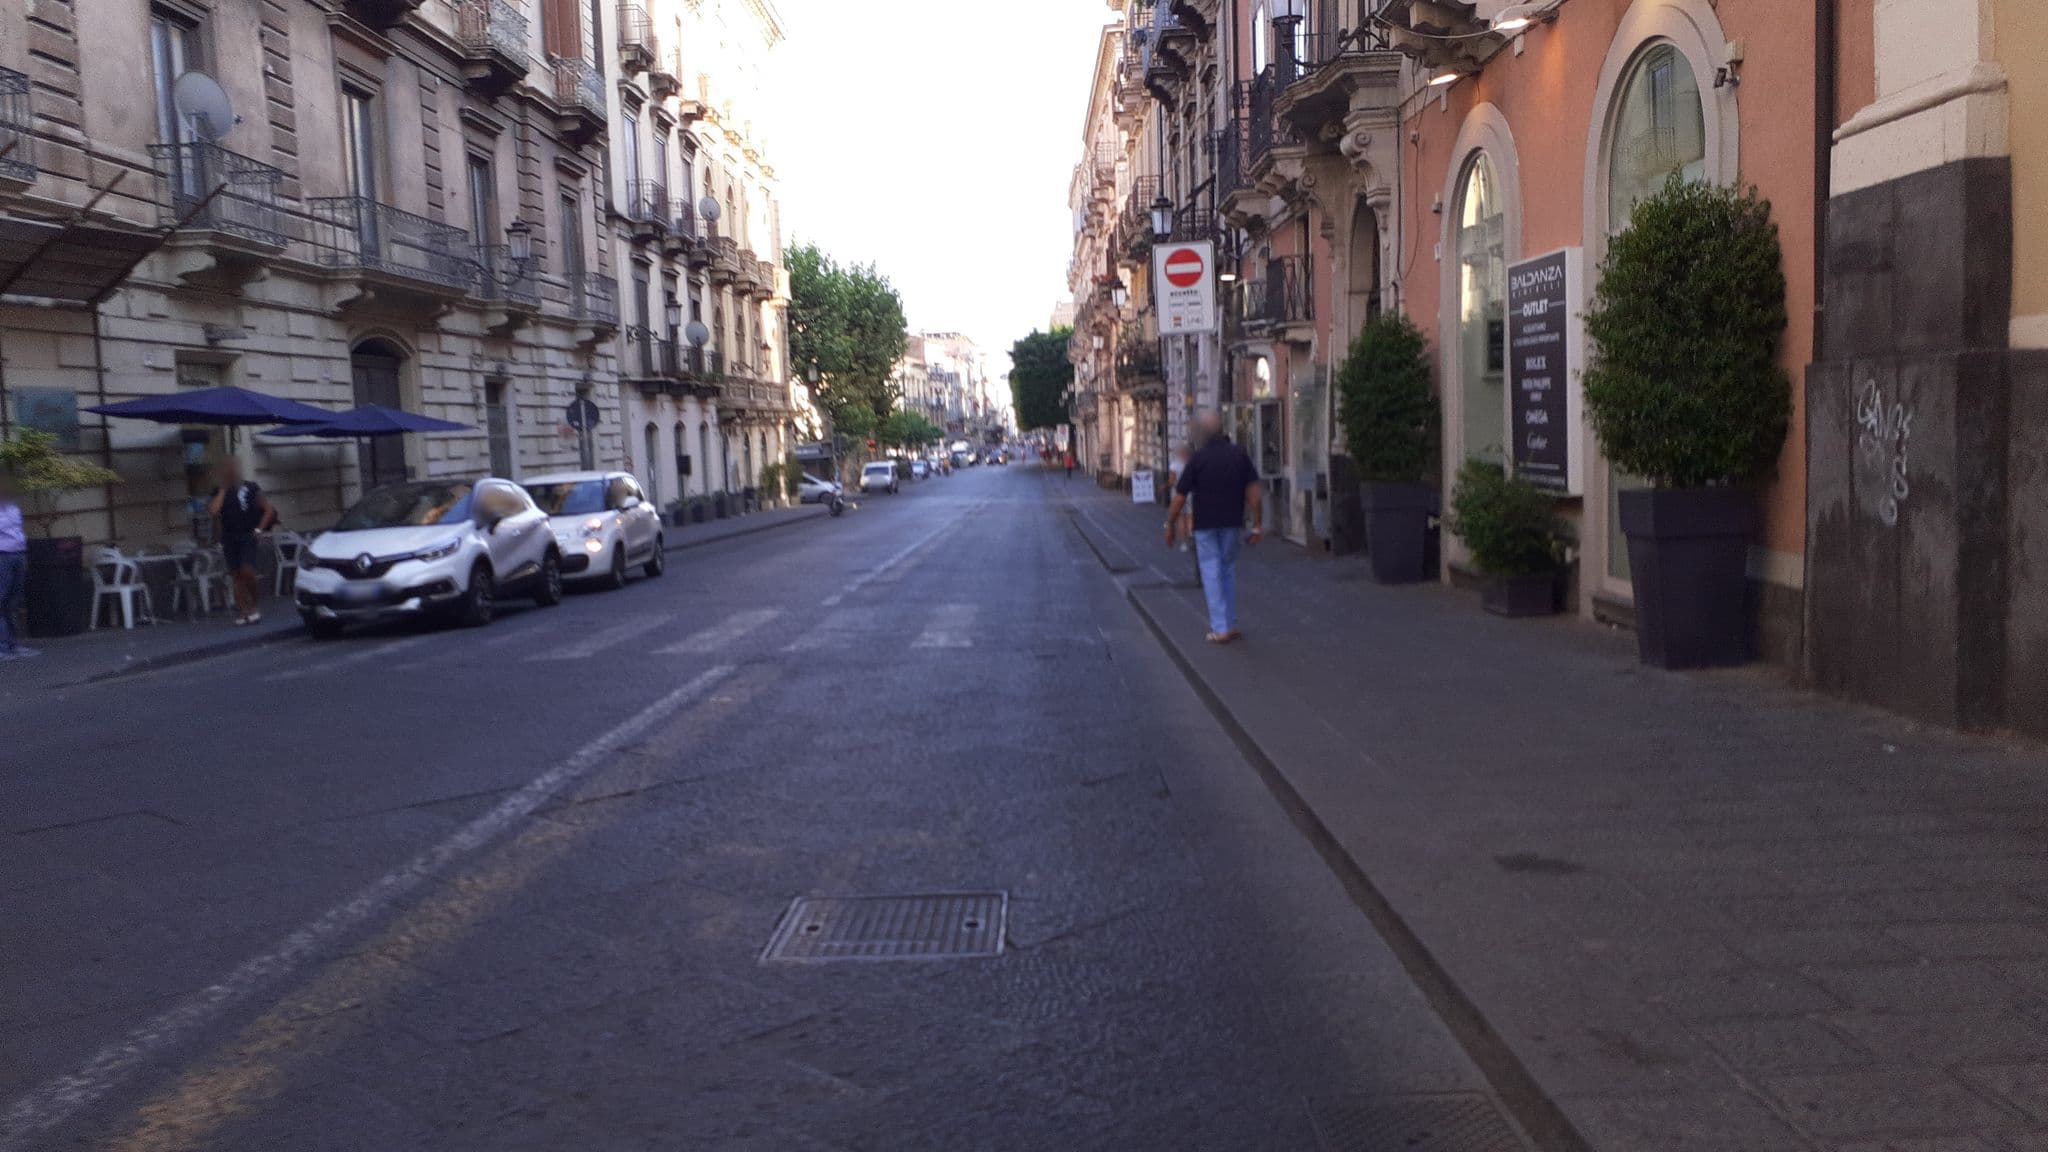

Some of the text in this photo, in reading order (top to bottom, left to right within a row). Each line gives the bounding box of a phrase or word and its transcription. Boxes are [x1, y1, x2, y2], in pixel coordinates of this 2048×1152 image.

[1511, 265, 1562, 290] BALDANZA
[1522, 299, 1548, 317] OUTLET
[1525, 409, 1548, 424] OMEGA
